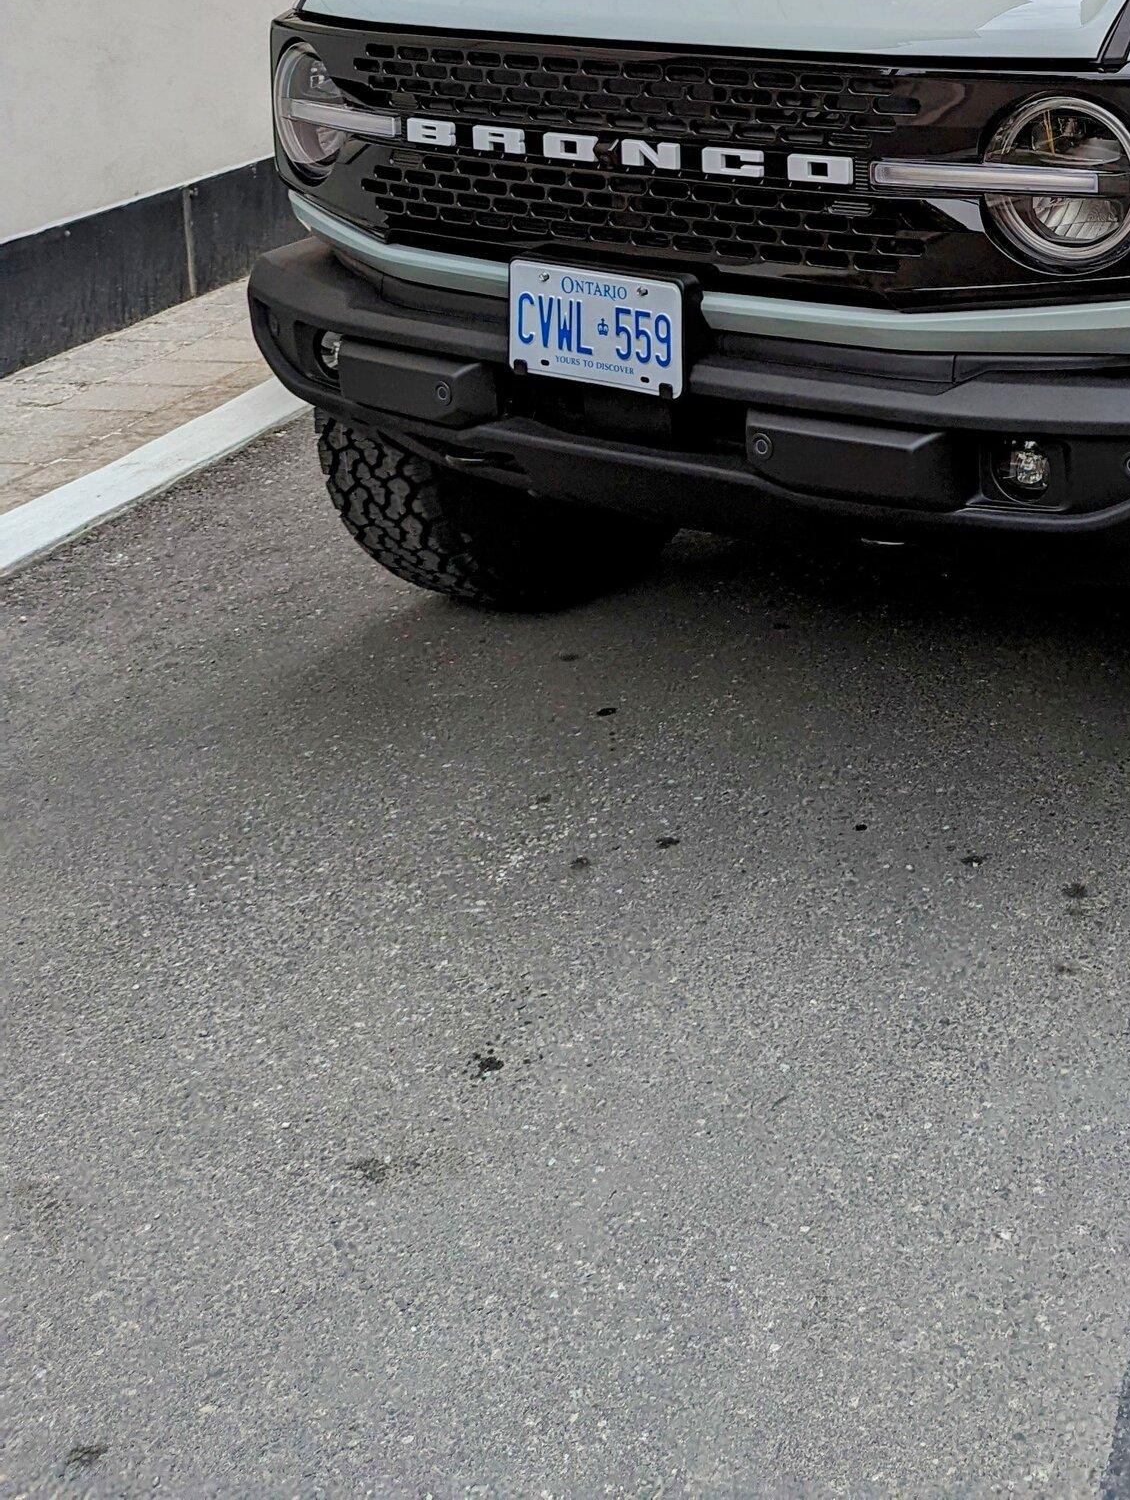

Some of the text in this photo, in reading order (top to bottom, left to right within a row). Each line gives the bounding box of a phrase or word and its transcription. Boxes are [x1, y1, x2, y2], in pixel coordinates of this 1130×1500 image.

[407, 117, 854, 186] BRONCO
[561, 276, 628, 301] ONTARIO
[518, 291, 673, 368] CVWL 559
[555, 355, 635, 375] YOURS TO DISCOVER
